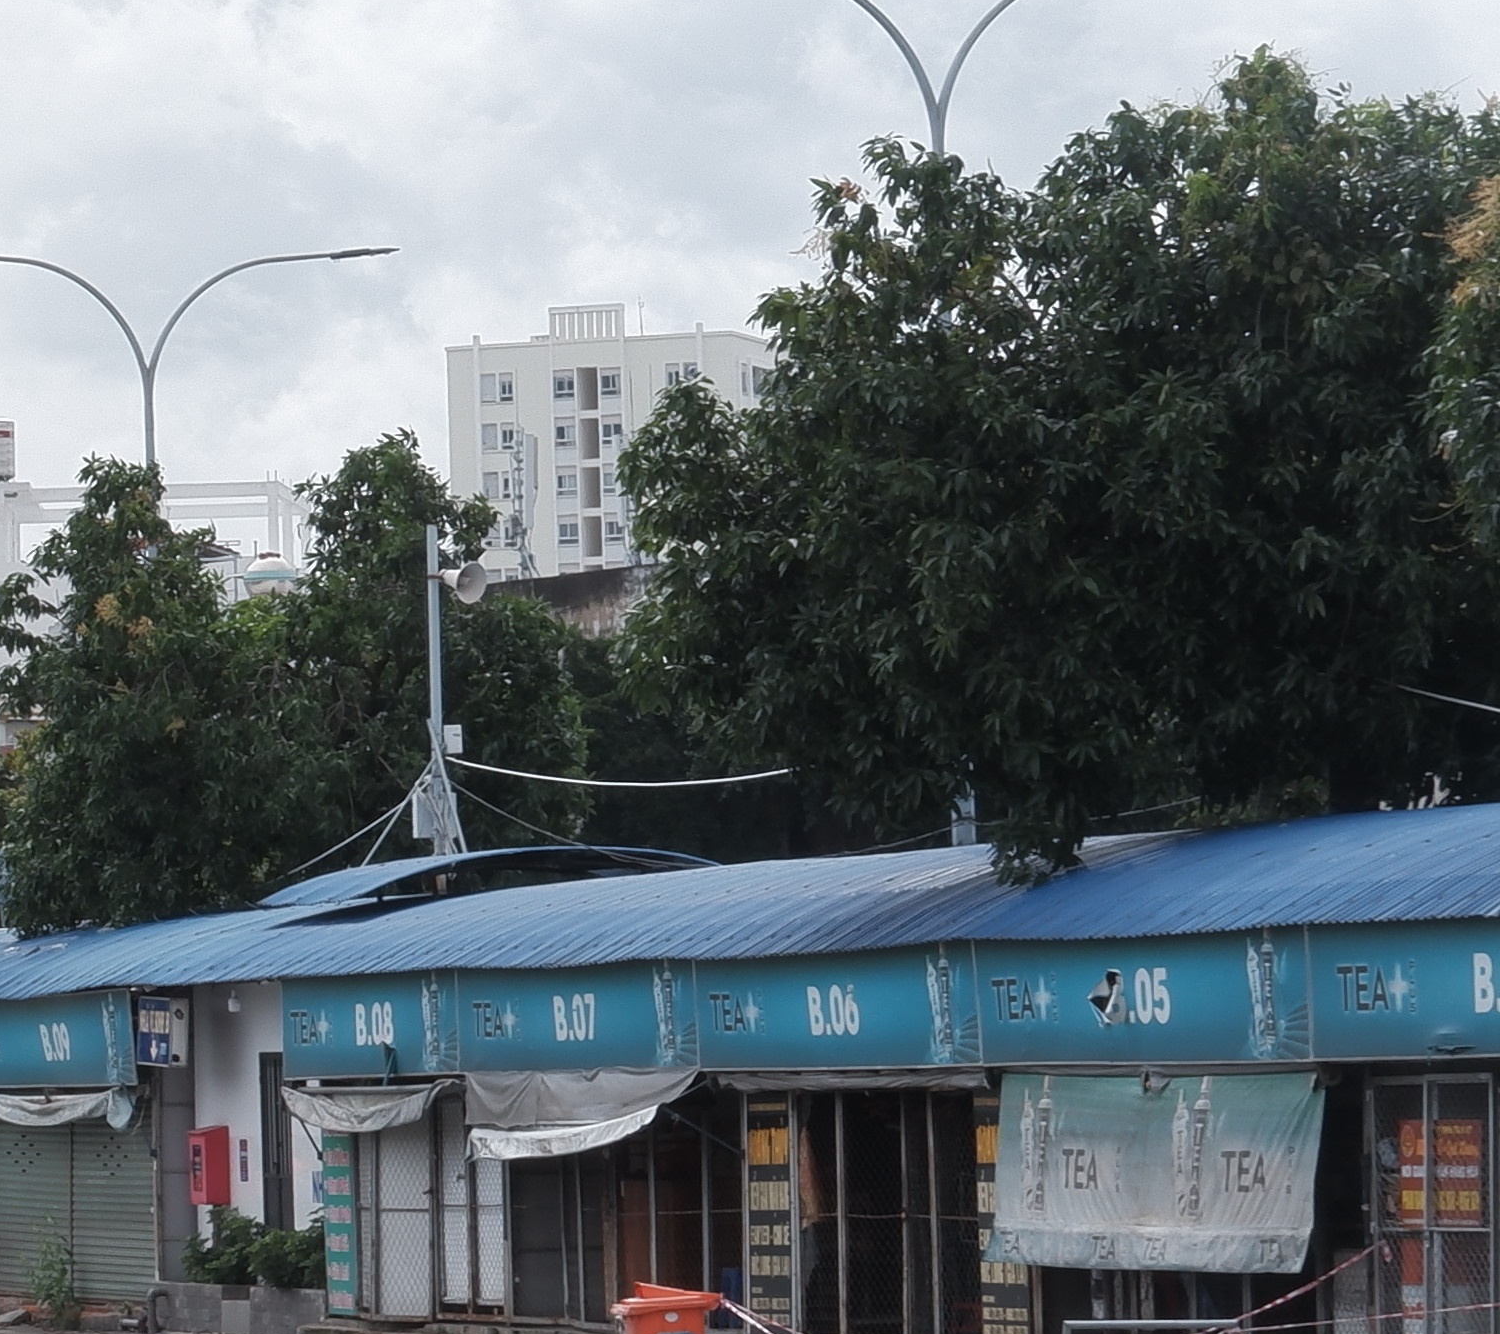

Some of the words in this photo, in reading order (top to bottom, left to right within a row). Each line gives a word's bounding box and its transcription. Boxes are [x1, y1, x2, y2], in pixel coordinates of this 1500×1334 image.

[355, 1001, 394, 1046] B.08
[553, 993, 595, 1042] B.07
[806, 982, 860, 1036] B.06
[39, 1022, 71, 1062] B.09
[1062, 1148, 1099, 1189] TEA
[1220, 1150, 1266, 1193] TEA
